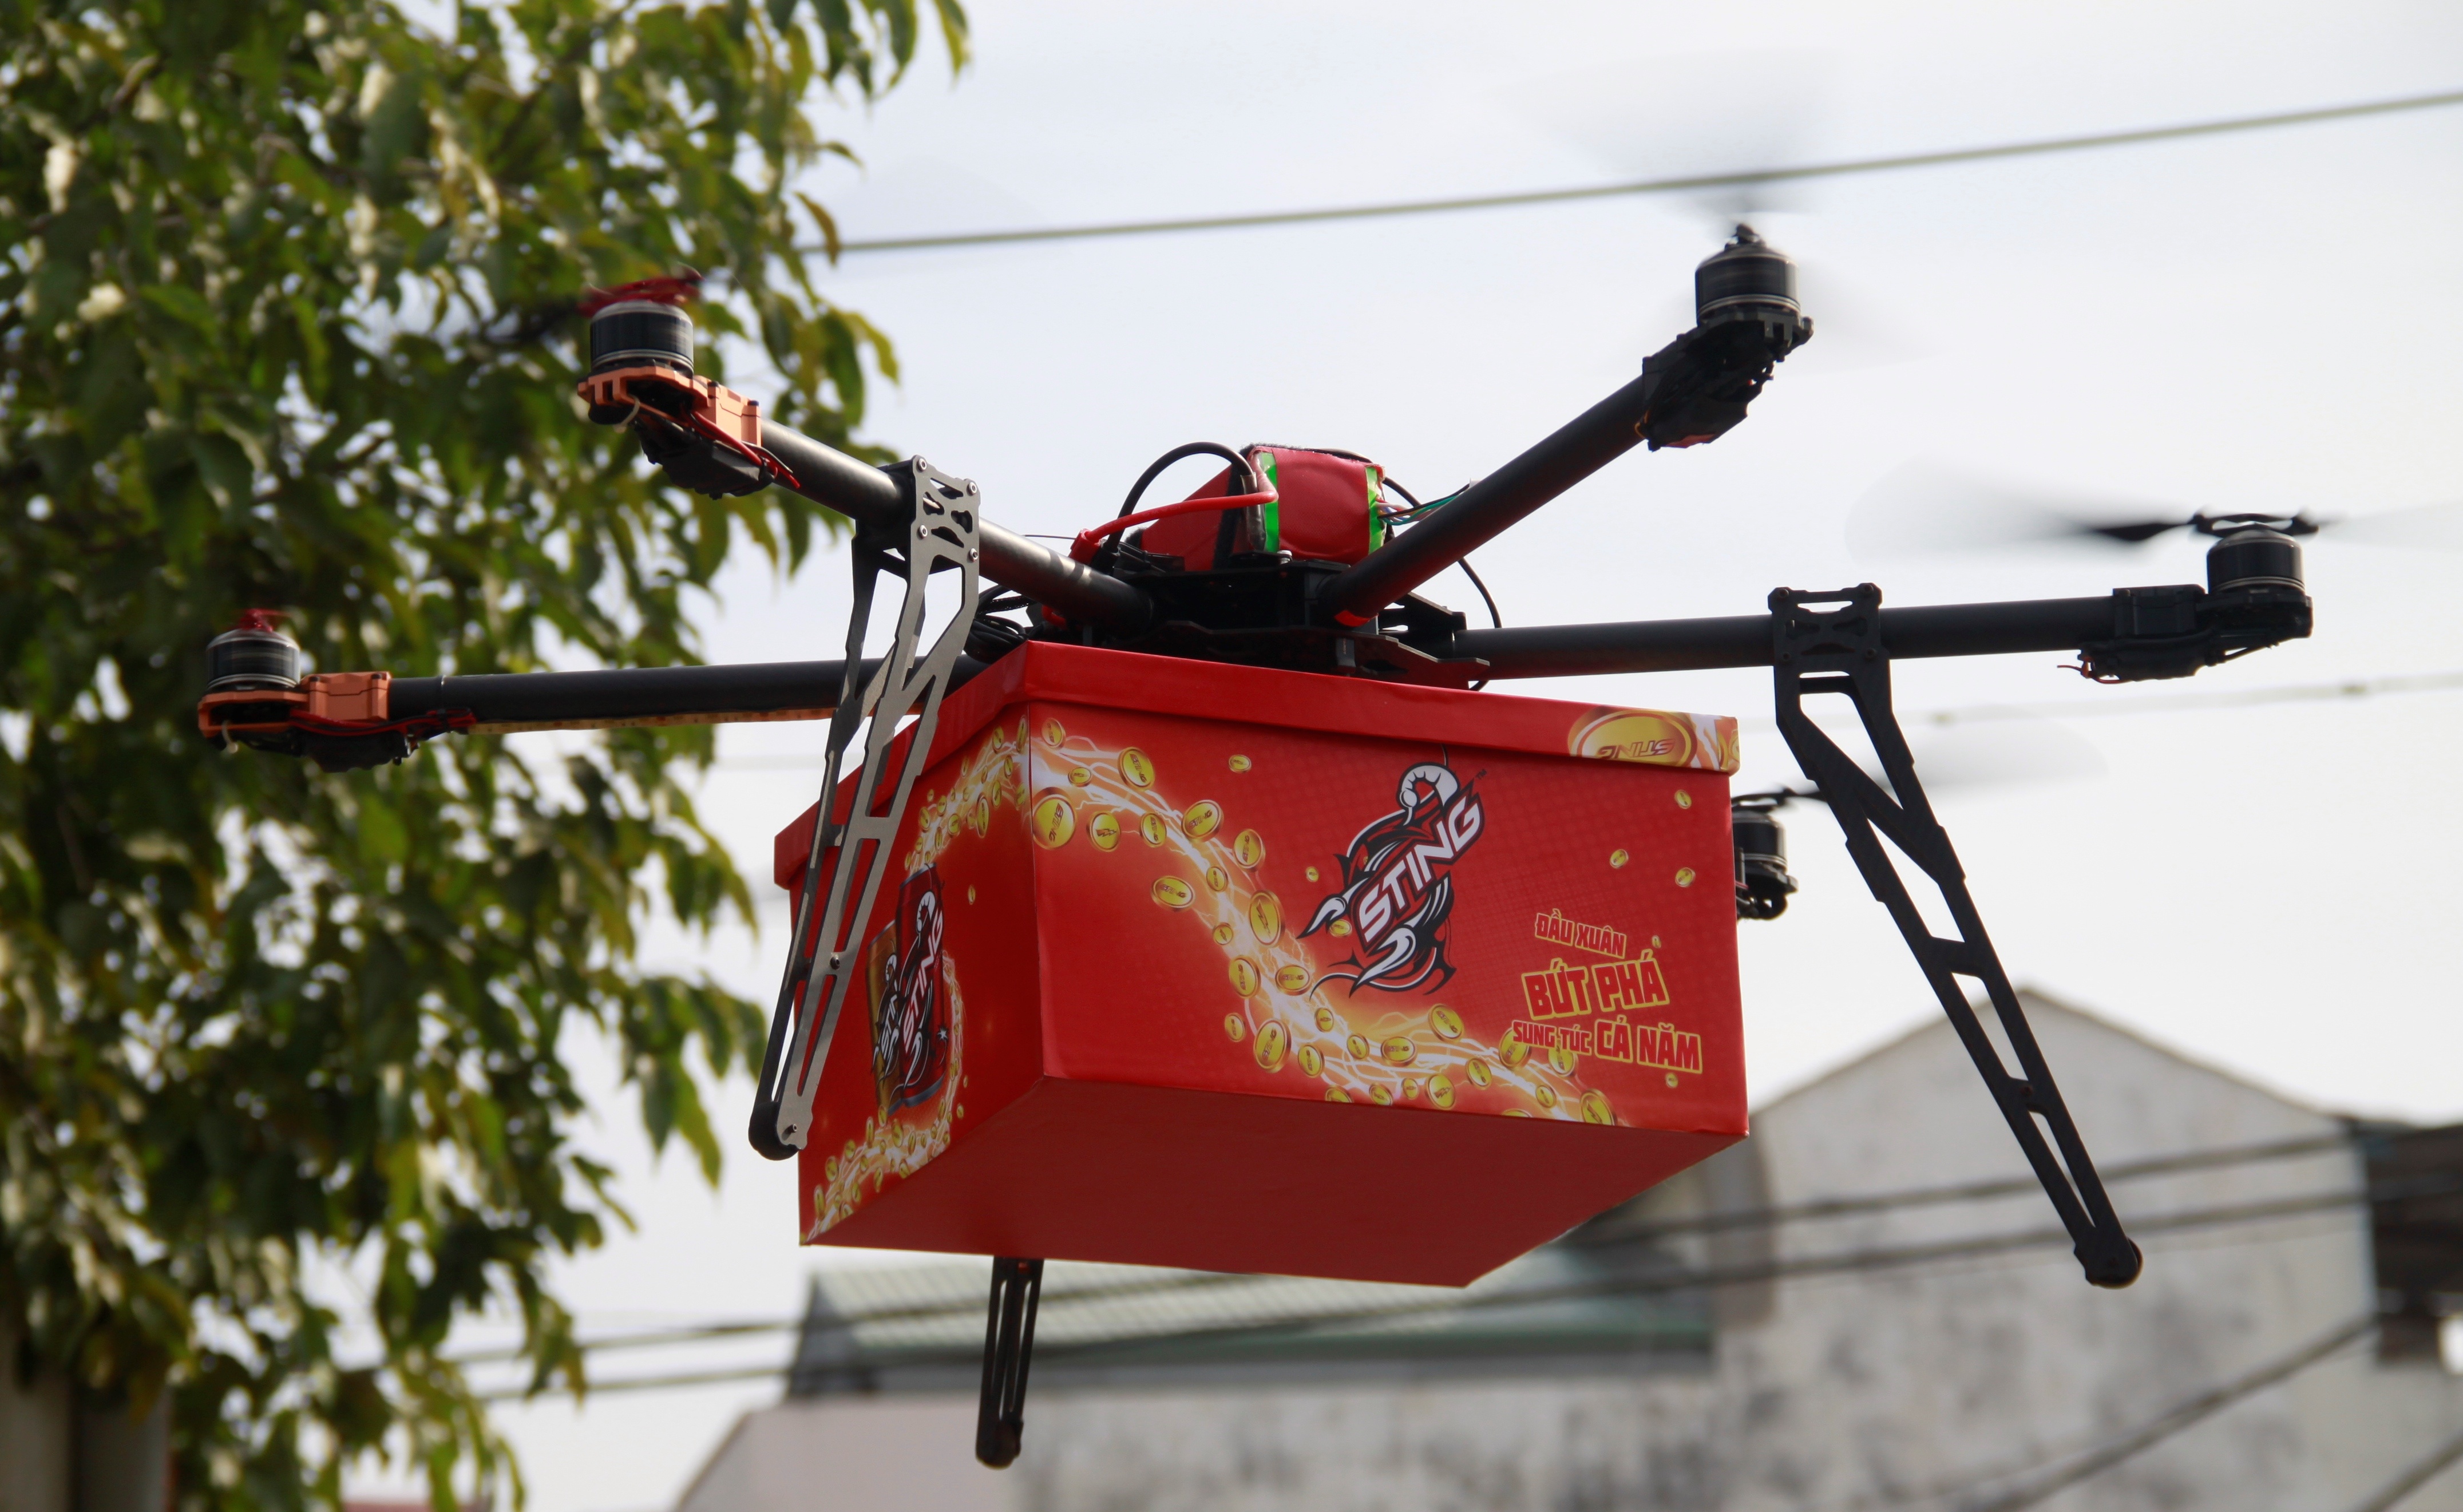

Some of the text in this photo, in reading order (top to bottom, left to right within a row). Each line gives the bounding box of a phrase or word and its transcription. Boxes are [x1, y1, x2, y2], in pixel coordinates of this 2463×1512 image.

[1357, 794, 1482, 944] STING
[1535, 908, 1626, 959] ĐẦU XUÂN
[904, 908, 943, 1054] STING
[1522, 949, 1670, 1020] BÚT PHÁ
[881, 979, 897, 1060] STIN
[1512, 1020, 1557, 1049] SUNG
[1558, 1024, 1592, 1056] TÚC
[1594, 1015, 1633, 1063] CẢ
[1637, 1022, 1702, 1074] NĂM
